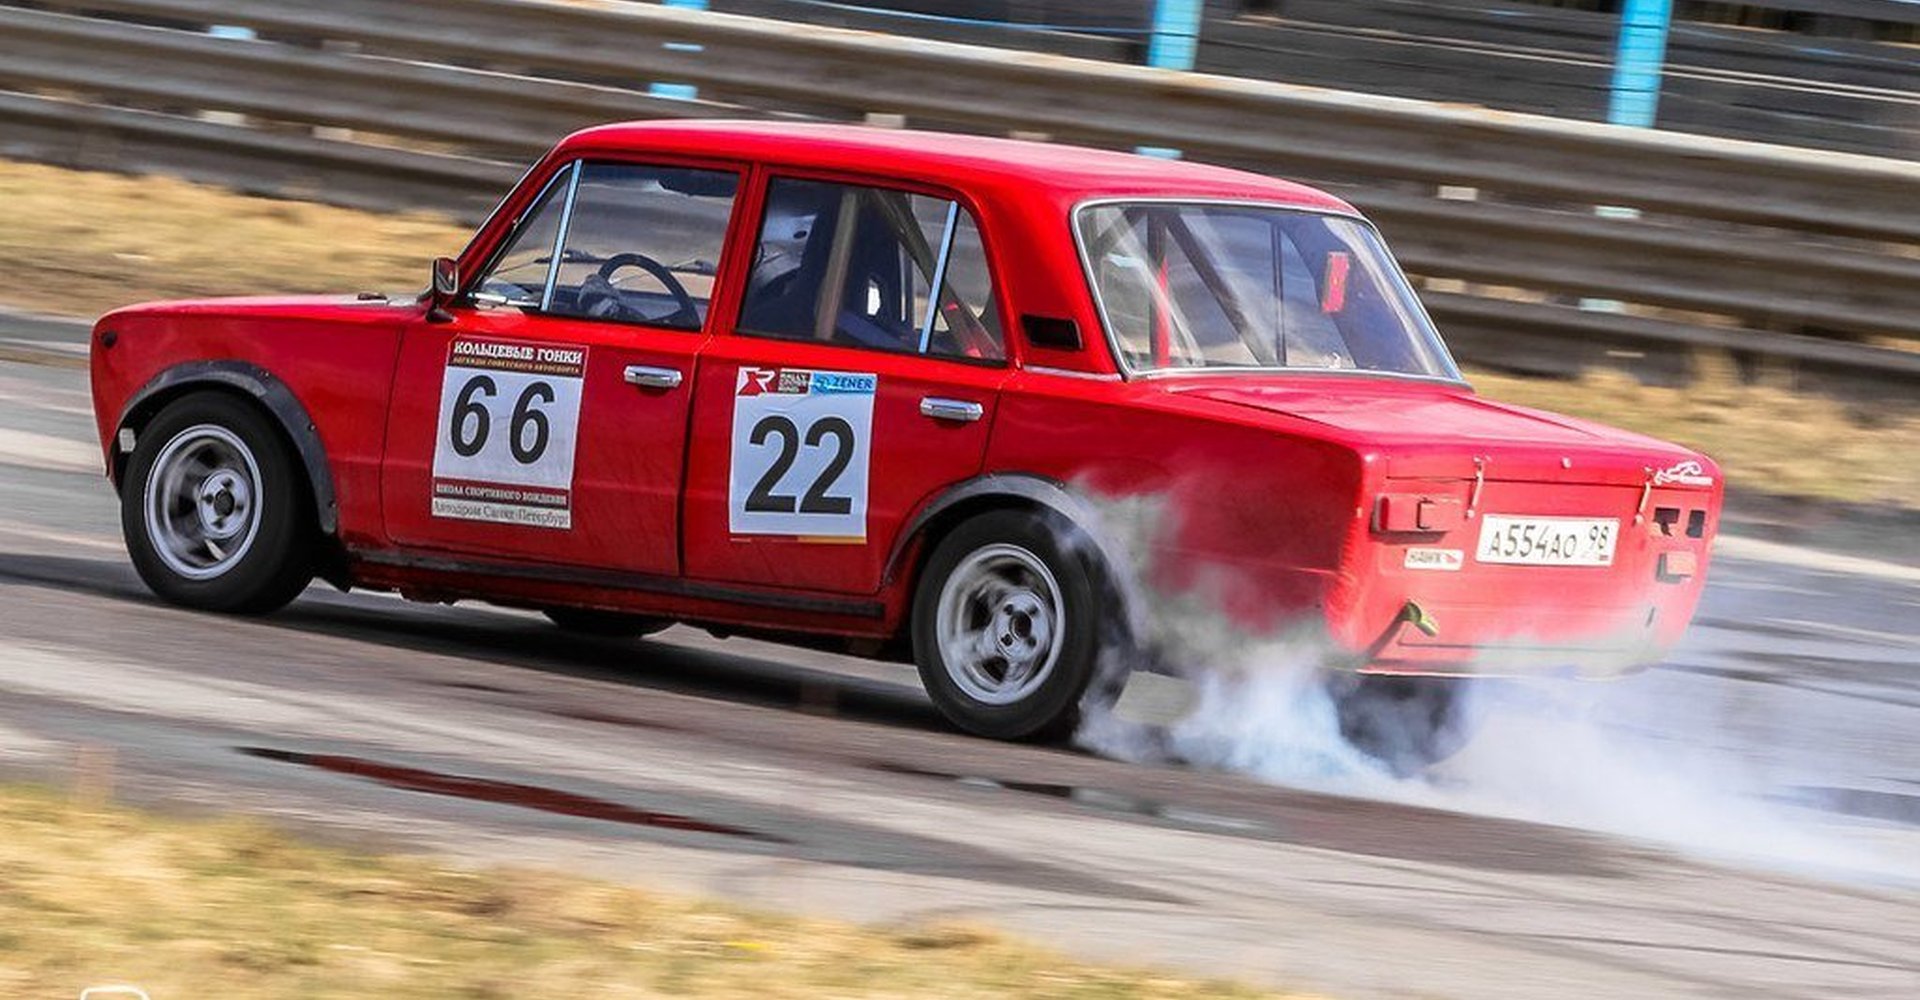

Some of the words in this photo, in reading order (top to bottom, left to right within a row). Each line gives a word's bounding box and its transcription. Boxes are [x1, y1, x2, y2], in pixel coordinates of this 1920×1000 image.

[453, 341, 534, 360] КОЛЬЦЕВЫЕ
[536, 348, 583, 364] ГОНКИ
[834, 377, 874, 390] ZENER
[450, 374, 555, 465] 66
[745, 415, 855, 515] 22
[434, 501, 483, 518] Автодром
[1589, 525, 1610, 550] 98
